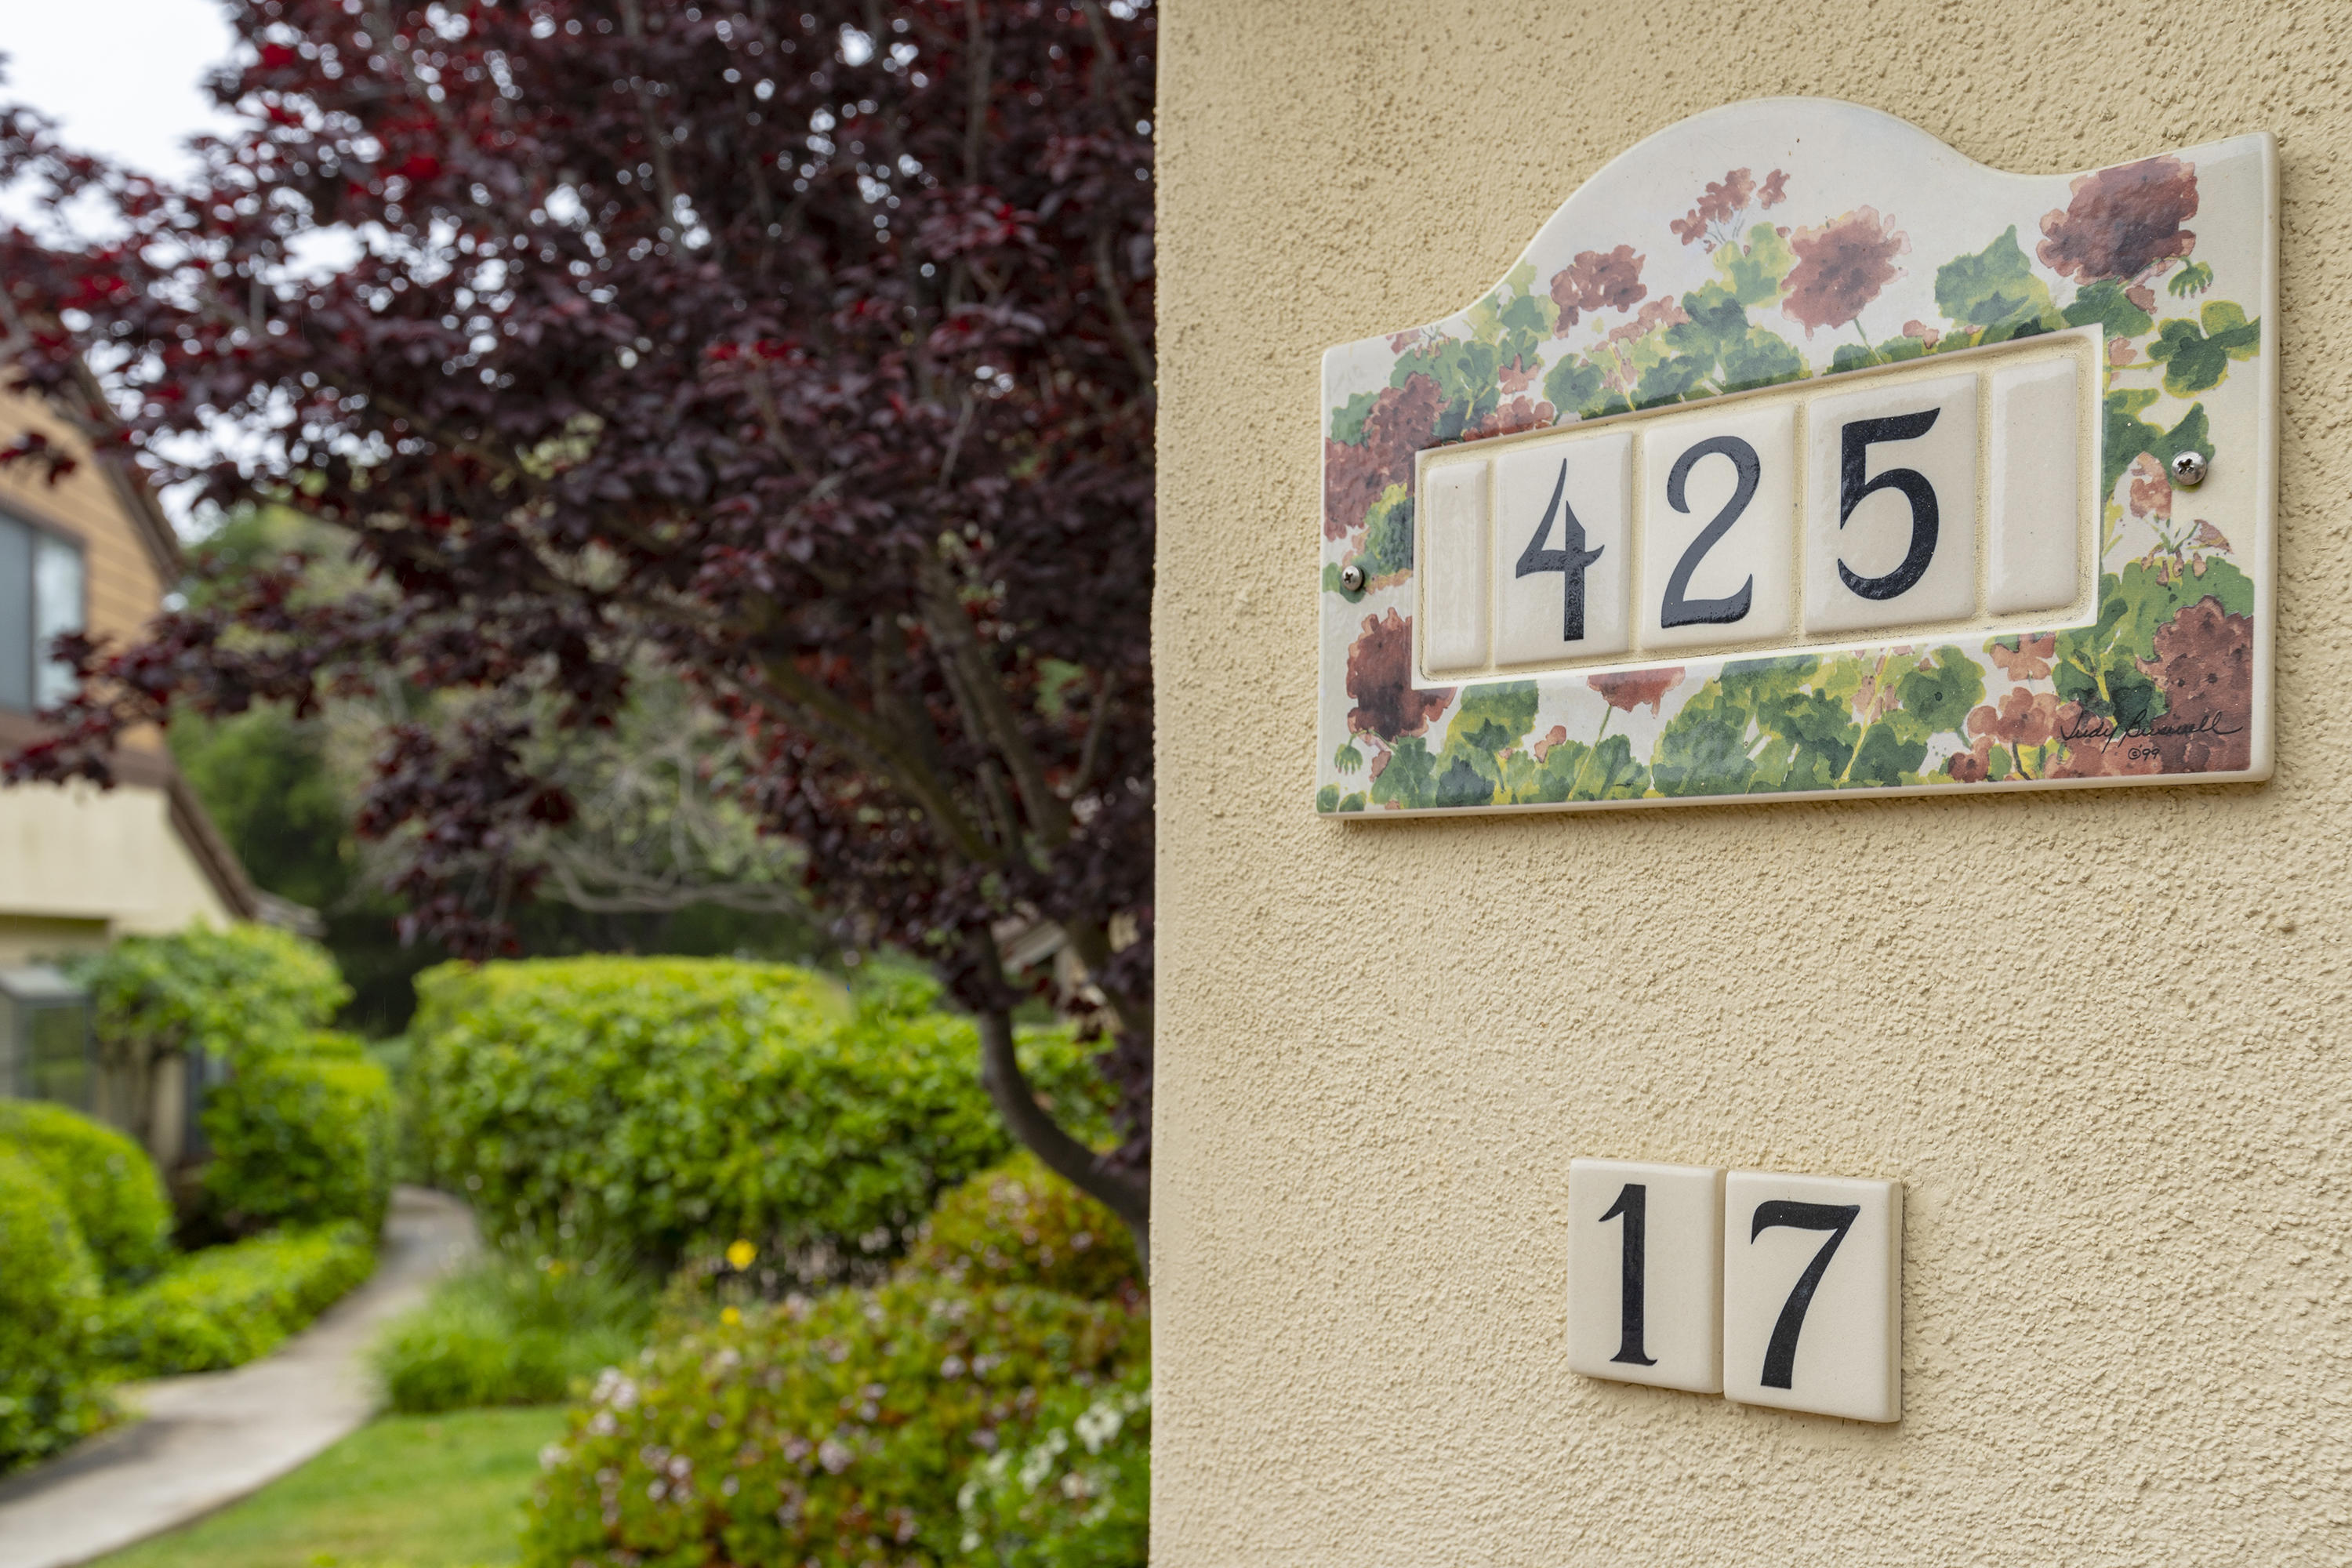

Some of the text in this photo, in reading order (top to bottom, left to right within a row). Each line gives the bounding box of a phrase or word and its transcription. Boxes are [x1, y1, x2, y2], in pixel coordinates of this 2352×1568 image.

[1515, 407, 1940, 642] 425
[2060, 706, 2118, 753] Judy
[1598, 1183, 1861, 1390] 17
